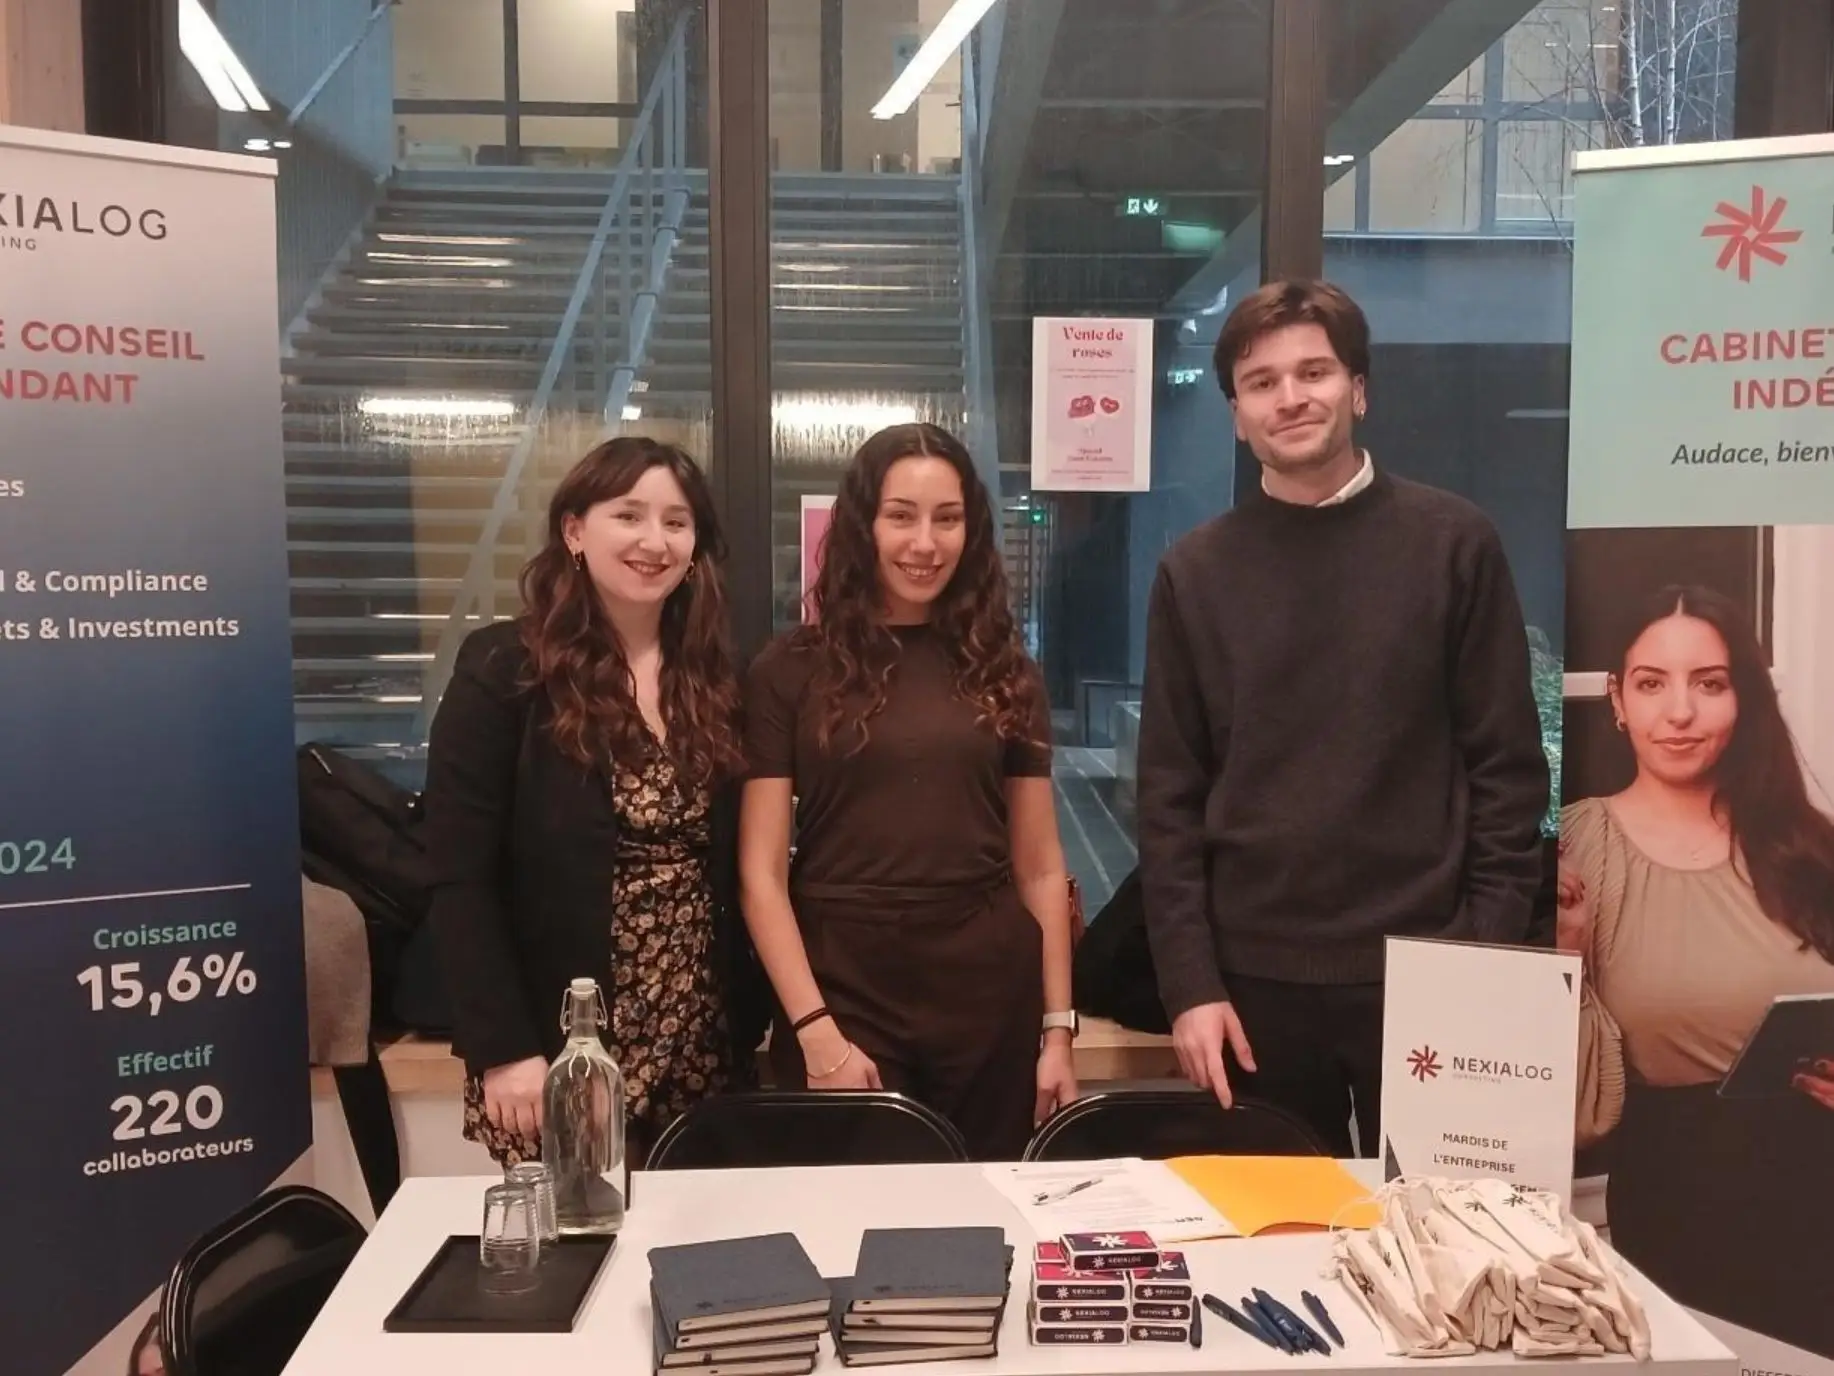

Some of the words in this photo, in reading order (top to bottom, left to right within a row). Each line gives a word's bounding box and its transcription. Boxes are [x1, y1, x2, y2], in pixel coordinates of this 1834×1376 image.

[0, 193, 168, 240] IALOG
[20, 320, 205, 361] CONSEIL
[1062, 326, 1104, 341] Vente
[1106, 327, 1124, 341] de
[1072, 347, 1113, 359] roses
[1671, 442, 1768, 466] Audace,
[15, 570, 36, 592] &
[45, 569, 209, 598] Compliance
[0, 619, 30, 640] ts
[39, 617, 60, 640] &
[68, 616, 240, 640] Investments
[93, 920, 237, 950] Croissance
[76, 951, 257, 1016] 15,6%
[117, 1044, 214, 1077] Effectif
[1452, 1056, 1553, 1081] NEXIALOG
[110, 1084, 224, 1141] 220
[1442, 1132, 1489, 1148] MARDIS
[1492, 1138, 1508, 1151] DE
[83, 1137, 254, 1177] collaborateurs
[1433, 1153, 1516, 1174] L'ENTREPRISE
